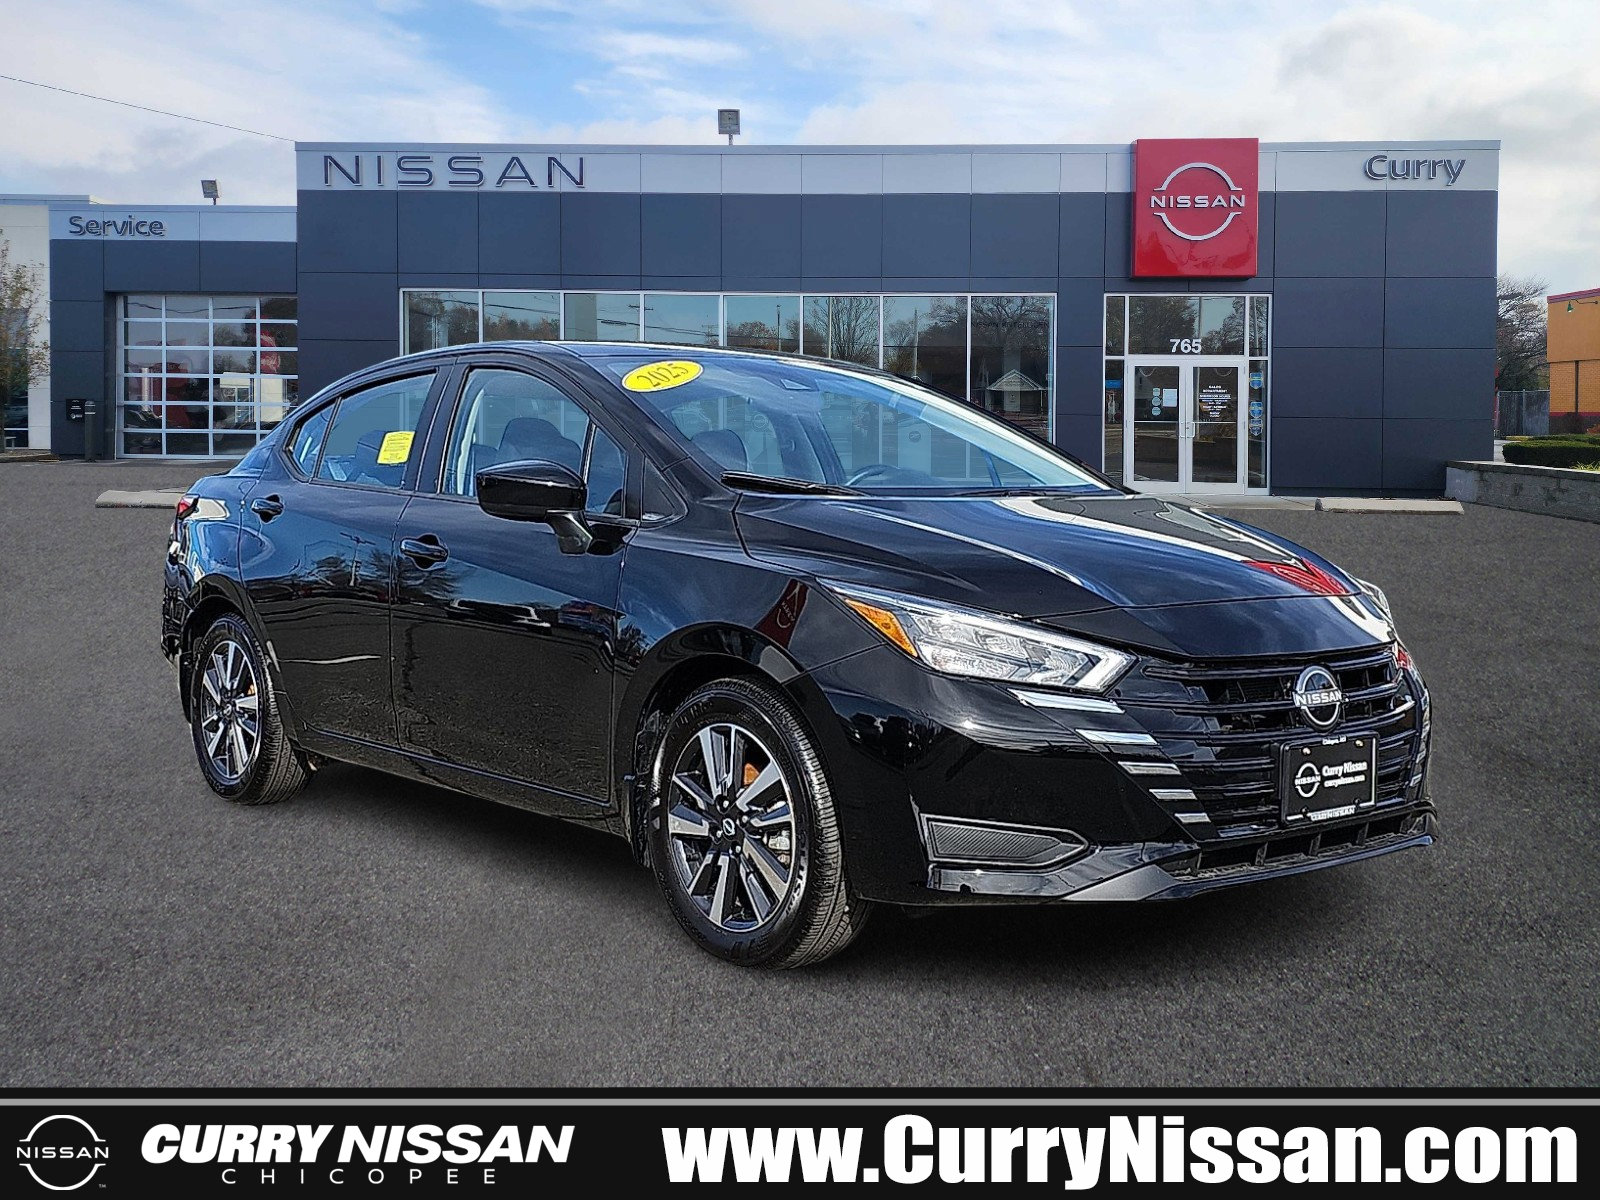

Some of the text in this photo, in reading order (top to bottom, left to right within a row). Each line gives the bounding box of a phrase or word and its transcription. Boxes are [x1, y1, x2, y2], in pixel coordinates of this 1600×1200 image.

[323, 155, 585, 188] NISSAN
[1364, 154, 1466, 186] Curry
[1150, 194, 1246, 209] NISSAN
[68, 214, 166, 237] Service
[1169, 338, 1203, 354] 765
[636, 363, 689, 388] 2025
[1294, 690, 1343, 708] NISSAN
[1322, 765, 1343, 777] Curry
[1294, 775, 1321, 786] NISSAN
